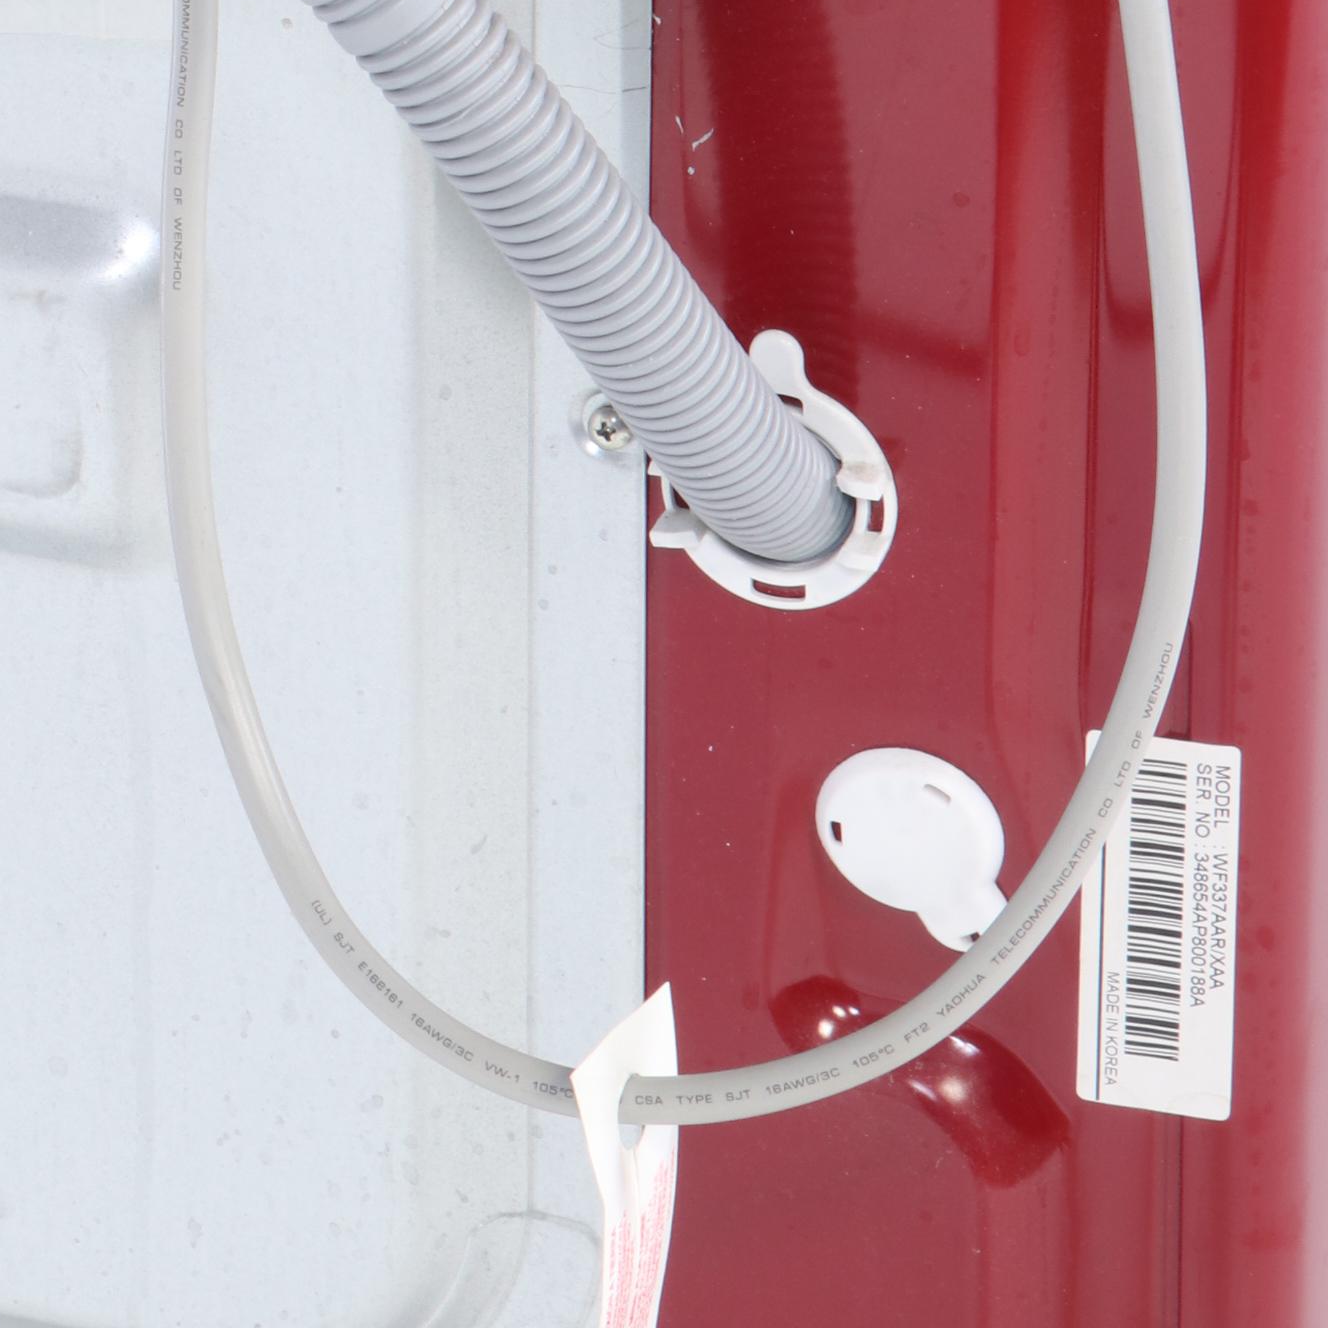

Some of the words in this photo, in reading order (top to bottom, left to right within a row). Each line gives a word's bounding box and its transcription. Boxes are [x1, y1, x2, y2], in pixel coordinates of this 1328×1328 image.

[174, 119, 184, 139] CO
[173, 150, 183, 176] LTD
[173, 187, 182, 206] OF
[172, 218, 182, 291] WENZHOU
[1196, 764, 1212, 802] SER.
[1213, 765, 1231, 828] MODEL
[1195, 813, 1211, 838] NO
[334, 932, 355, 955] SJT
[484, 1061, 520, 1084] VW-1
[635, 1094, 663, 1106] CSA
[676, 1094, 713, 1105] TYPE
[726, 1089, 752, 1102] SJT
[852, 1044, 895, 1070] 105°C
[903, 1022, 931, 1044] FT2
[937, 973, 986, 1018] YAOHUA
[990, 828, 1096, 966] TELECOMMUNICATION
[1098, 798, 1113, 818] CO
[1114, 761, 1131, 787] LTD
[1131, 732, 1143, 750] OF
[1143, 642, 1173, 719] WENZHOU
[1189, 852, 1209, 1008] 348654AP800188A
[1209, 853, 1230, 990] WF337AAR/XAA
[1106, 972, 1120, 1012] MADE
[1106, 1015, 1118, 1032] IN
[1104, 1034, 1118, 1086] KOREA
